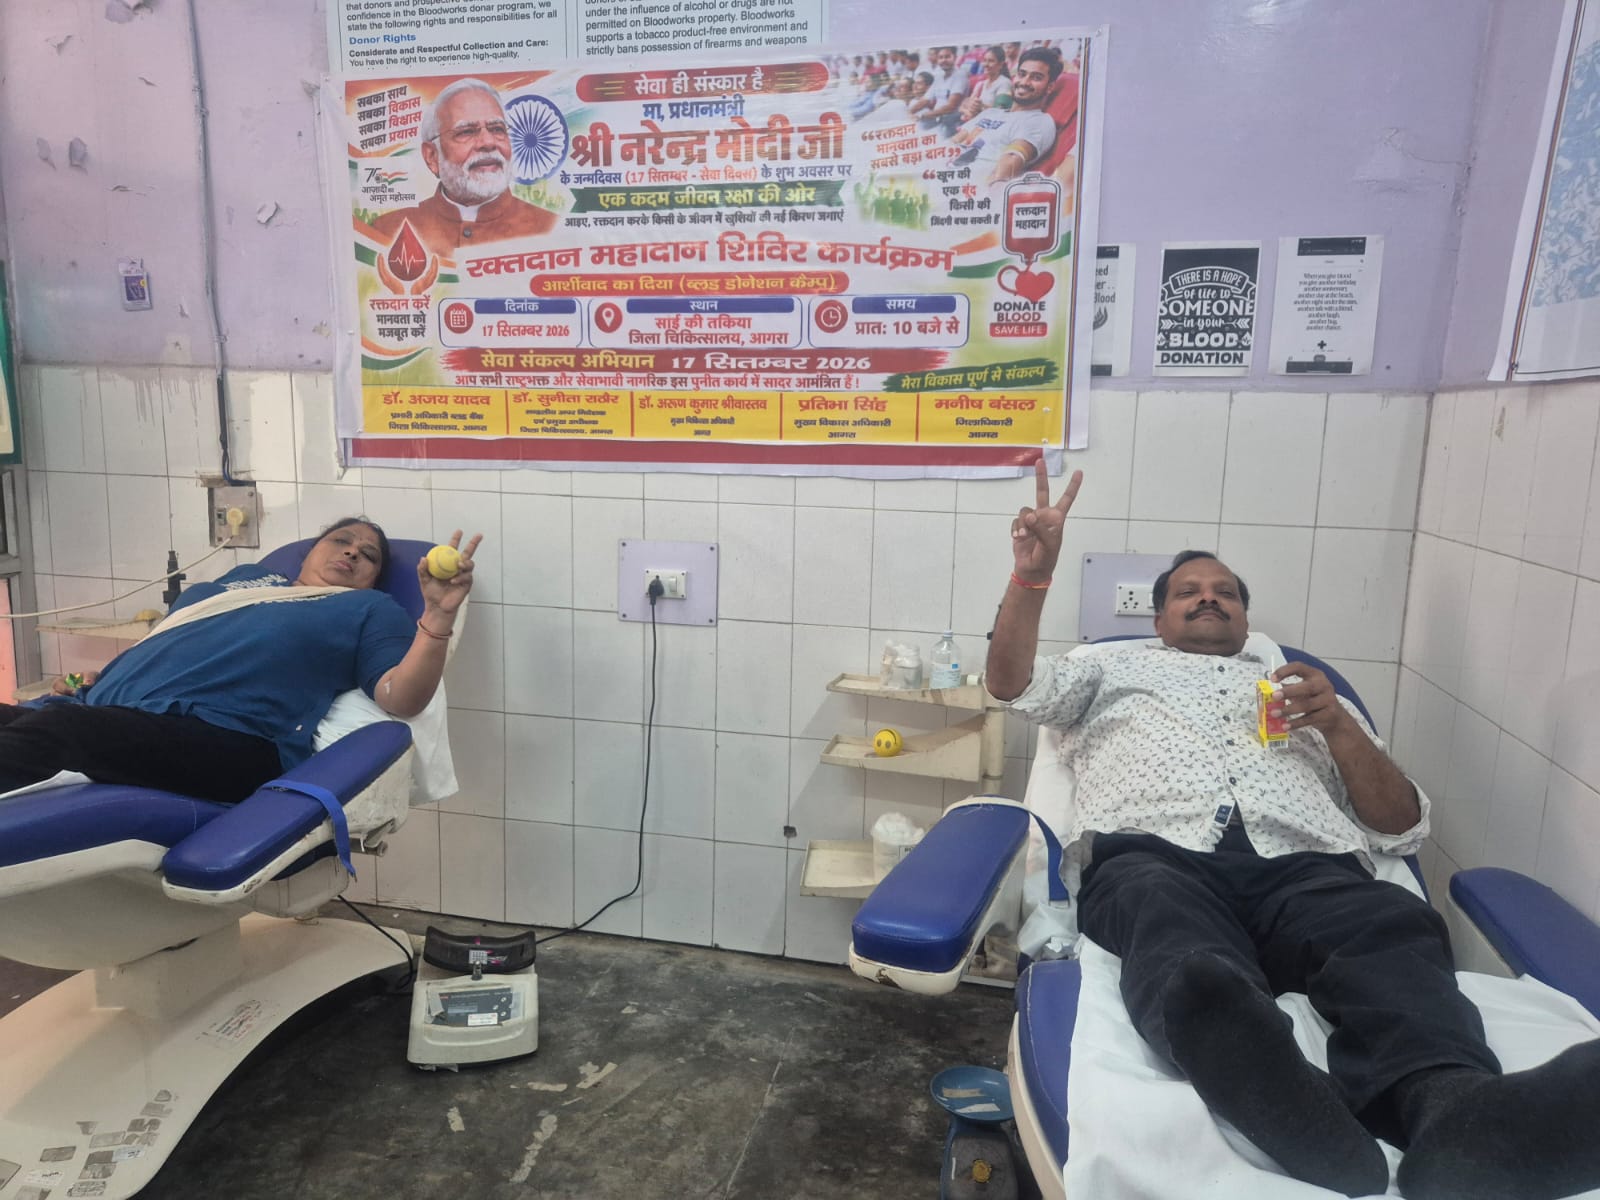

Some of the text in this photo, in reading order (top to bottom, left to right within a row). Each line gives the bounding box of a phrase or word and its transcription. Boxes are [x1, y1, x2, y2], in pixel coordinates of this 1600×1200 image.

[347, 11, 391, 21] confidence
[418, 6, 467, 16] Bloodworks
[497, 3, 536, 12] program,
[385, 20, 420, 30] following
[423, 18, 446, 27] rights
[467, 12, 530, 24] responsibilities
[586, 20, 626, 31] permitted
[644, 15, 695, 26] Bloodworks
[698, 14, 738, 25] property.
[741, 10, 794, 21] Bloodworks
[349, 34, 416, 44] Donor Rights
[586, 33, 624, 44] supports
[635, 30, 669, 40] tobacco
[673, 26, 727, 39] product-free
[730, 23, 787, 34] environment
[790, 21, 807, 31] and
[349, 49, 397, 57] Considerate
[417, 44, 460, 54] Respectful
[463, 41, 504, 50] Collection
[586, 35, 807, 56] strictly bans possession of firearms and weapons
[400, 56, 417, 66] right
[428, 53, 470, 63] experience
[635, 67, 764, 95] सेवा ही संस्कार है
[358, 85, 407, 107] सबका साथ
[358, 97, 421, 121] सबका विकास
[668, 94, 745, 120] प्रधानमंत्री
[359, 119, 386, 135] सबका
[360, 127, 418, 150] सबका प्रयास
[569, 112, 847, 166] श्री नरेन्द्र मोदी जी
[560, 165, 852, 185] के जन्मदिवस (17 सितम्बर सेवा दिवस) के शुभ अवसर पर
[599, 183, 816, 208] एक कदम जीवन रक्षा की ओर
[1015, 206, 1047, 216] रक्तदान
[1015, 218, 1047, 229] महादान
[465, 231, 955, 278] रक्तदान महादान शिविर कार्यक्रम
[1174, 270, 1244, 286] THERE IS A HOPE
[1184, 288, 1194, 299] of
[1198, 288, 1216, 299] life
[370, 295, 430, 311] रक्तदान करें
[504, 299, 539, 312] दिनांक
[689, 300, 718, 311] स्थान
[886, 299, 916, 310] समय
[993, 301, 1046, 312] DONATE
[1158, 300, 1255, 316] SOMEONE
[376, 311, 426, 325] मानवता को
[684, 313, 703, 329] की
[708, 314, 751, 329] तकिया
[997, 311, 1040, 322] BLOOD
[1183, 318, 1224, 330] in your
[379, 324, 426, 341] मजबूत करें
[482, 320, 569, 337] 17 सितम्बर 2026
[893, 322, 912, 334] 10
[917, 316, 942, 335] बजे
[946, 317, 960, 334] से
[994, 325, 1042, 335] SAVE LIFE
[629, 329, 788, 346] जिला चिकित्सालय, आगरा
[1169, 333, 1238, 347] BLOOD
[481, 349, 655, 368] सेवा संकल्प अभियान
[672, 352, 871, 369] 17 सितम्बर 2026
[1161, 352, 1243, 364] DONATION
[384, 392, 490, 405] डॉ. अजय यादव
[513, 392, 532, 403] डॉ.
[538, 392, 580, 406] सुनीता
[639, 396, 653, 409] डॉ.
[690, 398, 718, 414] कुमार
[721, 395, 767, 410] श्रीवास्तव
[798, 396, 887, 412] प्रतिभा सिंह
[935, 395, 1037, 411] मनीष बंसल
